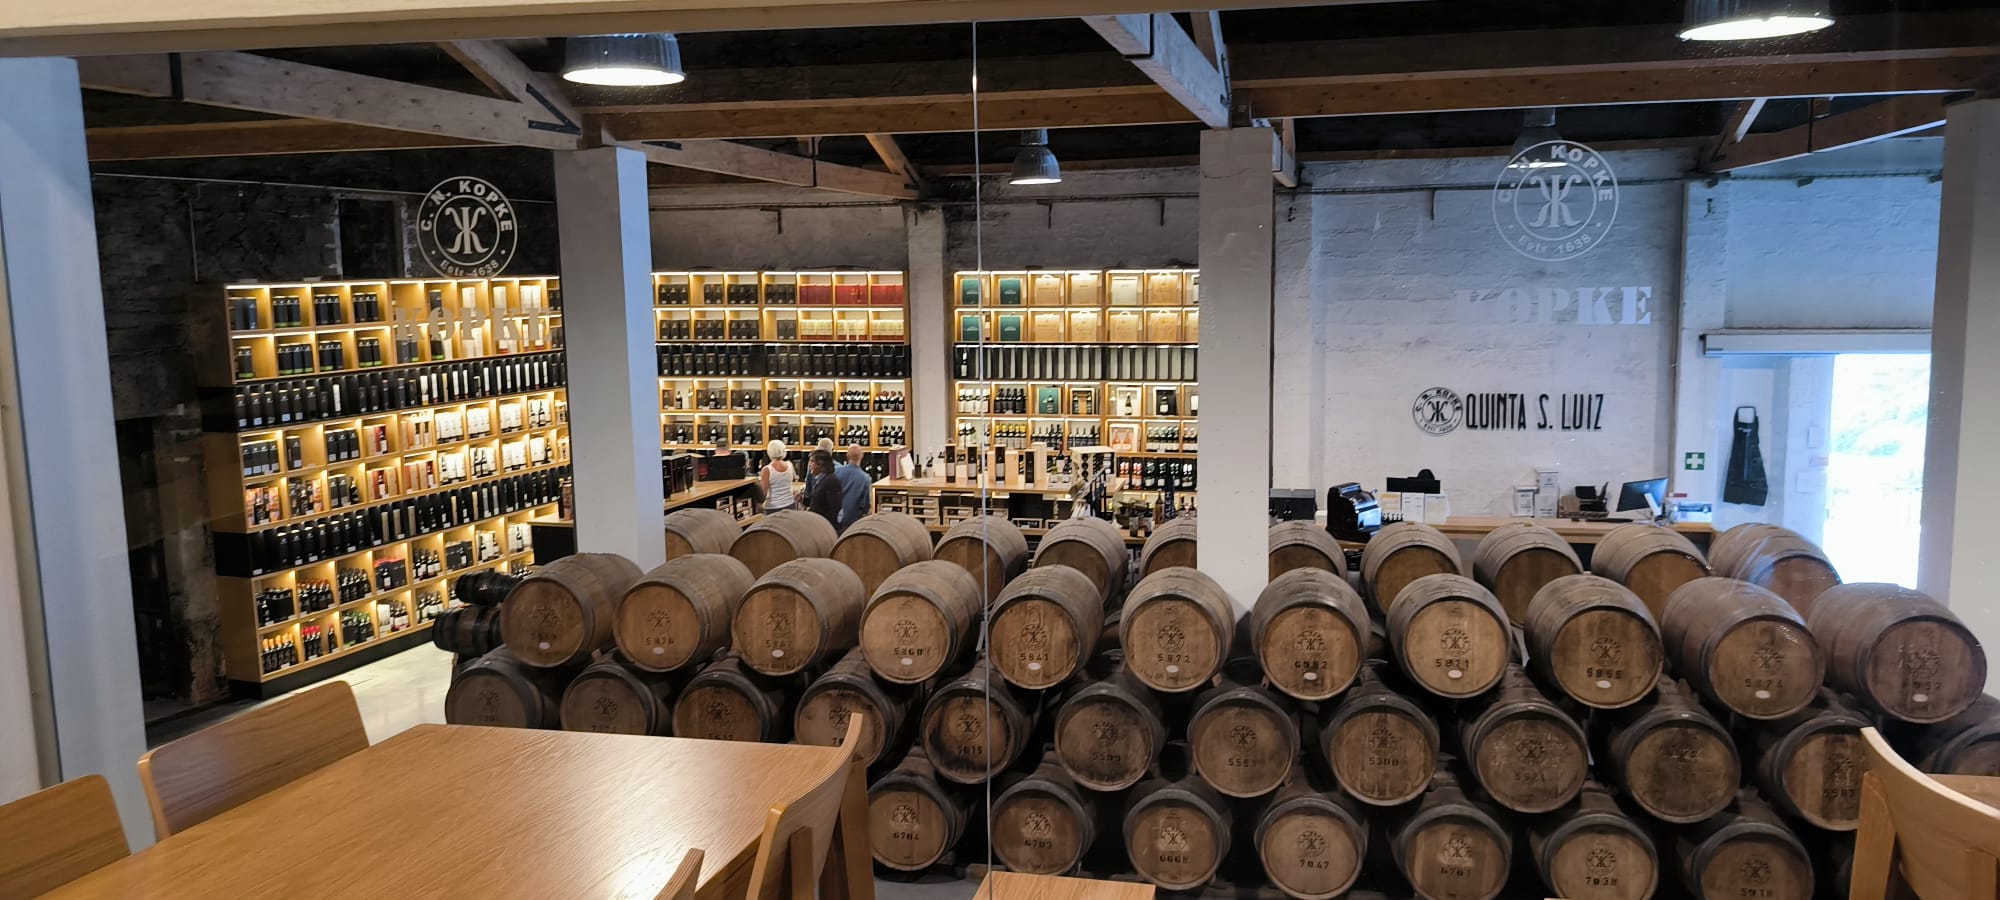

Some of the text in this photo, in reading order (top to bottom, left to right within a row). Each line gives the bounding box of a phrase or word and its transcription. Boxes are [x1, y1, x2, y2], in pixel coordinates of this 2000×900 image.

[1551, 145, 1613, 201] KOPKE
[459, 180, 512, 232] KOPKE
[471, 259, 499, 277] 1638
[395, 306, 552, 341] KOPKE
[1453, 286, 1652, 325] KOPKE
[1466, 393, 1605, 431] QUINTA S. LUIZ
[1157, 653, 1191, 664] 5872
